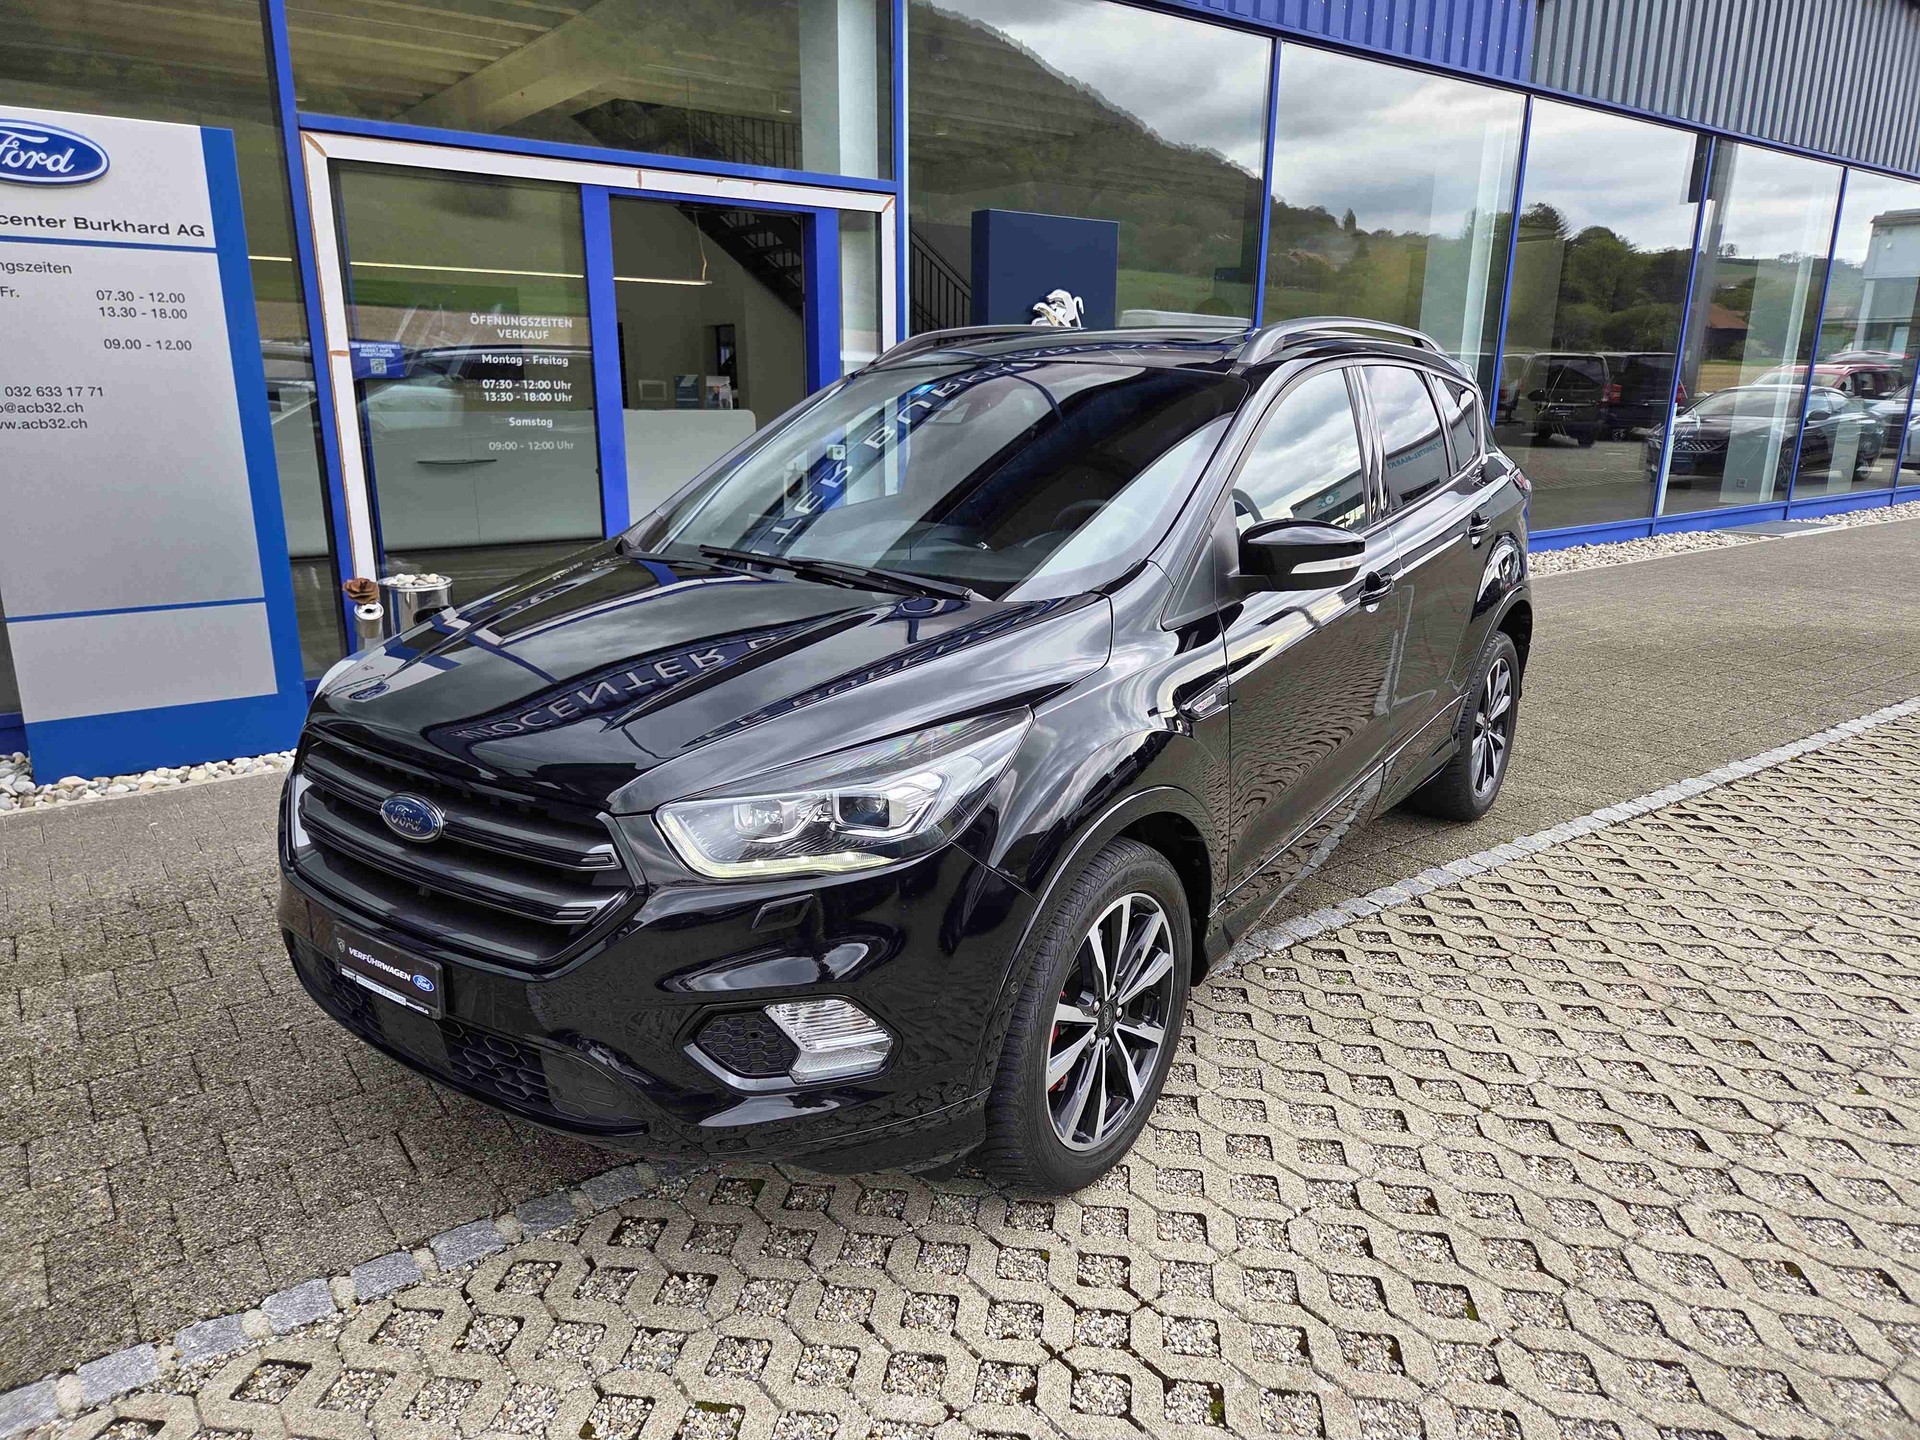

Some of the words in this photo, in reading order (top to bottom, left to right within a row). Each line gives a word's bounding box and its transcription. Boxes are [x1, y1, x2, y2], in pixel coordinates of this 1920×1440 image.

[0, 130, 76, 173] Ford
[74, 216, 170, 235] Burkhard
[177, 224, 205, 238] AG
[0, 286, 20, 298] Fr.
[96, 289, 135, 302] 07.30
[149, 292, 186, 304] 12.00
[99, 306, 137, 318] 13.30
[151, 308, 188, 320] 18.00
[470, 312, 573, 329] ÖFFNUNGSZEITEN
[497, 328, 550, 340] VERKAUF
[103, 338, 142, 350] 09.00
[155, 339, 192, 351] 12.00
[481, 354, 523, 366] Montag
[532, 355, 569, 367] Freitag
[482, 379, 513, 389] 07:30
[523, 380, 551, 390] 12:00
[553, 380, 572, 390] Uhr
[4, 386, 32, 397] 032
[36, 386, 63, 397] 633
[66, 386, 83, 397] 17
[87, 386, 104, 397] 71
[483, 392, 514, 402] 13:30
[523, 392, 552, 402] 18:00
[554, 392, 573, 402] Uhr
[0, 418, 88, 430] w.acb32.ch
[508, 417, 553, 428] Samstag
[488, 441, 518, 451] 09:00
[528, 440, 554, 450] 12:00
[557, 440, 574, 450] Uhr
[348, 946, 412, 982] VERFÜHRWAGEN
